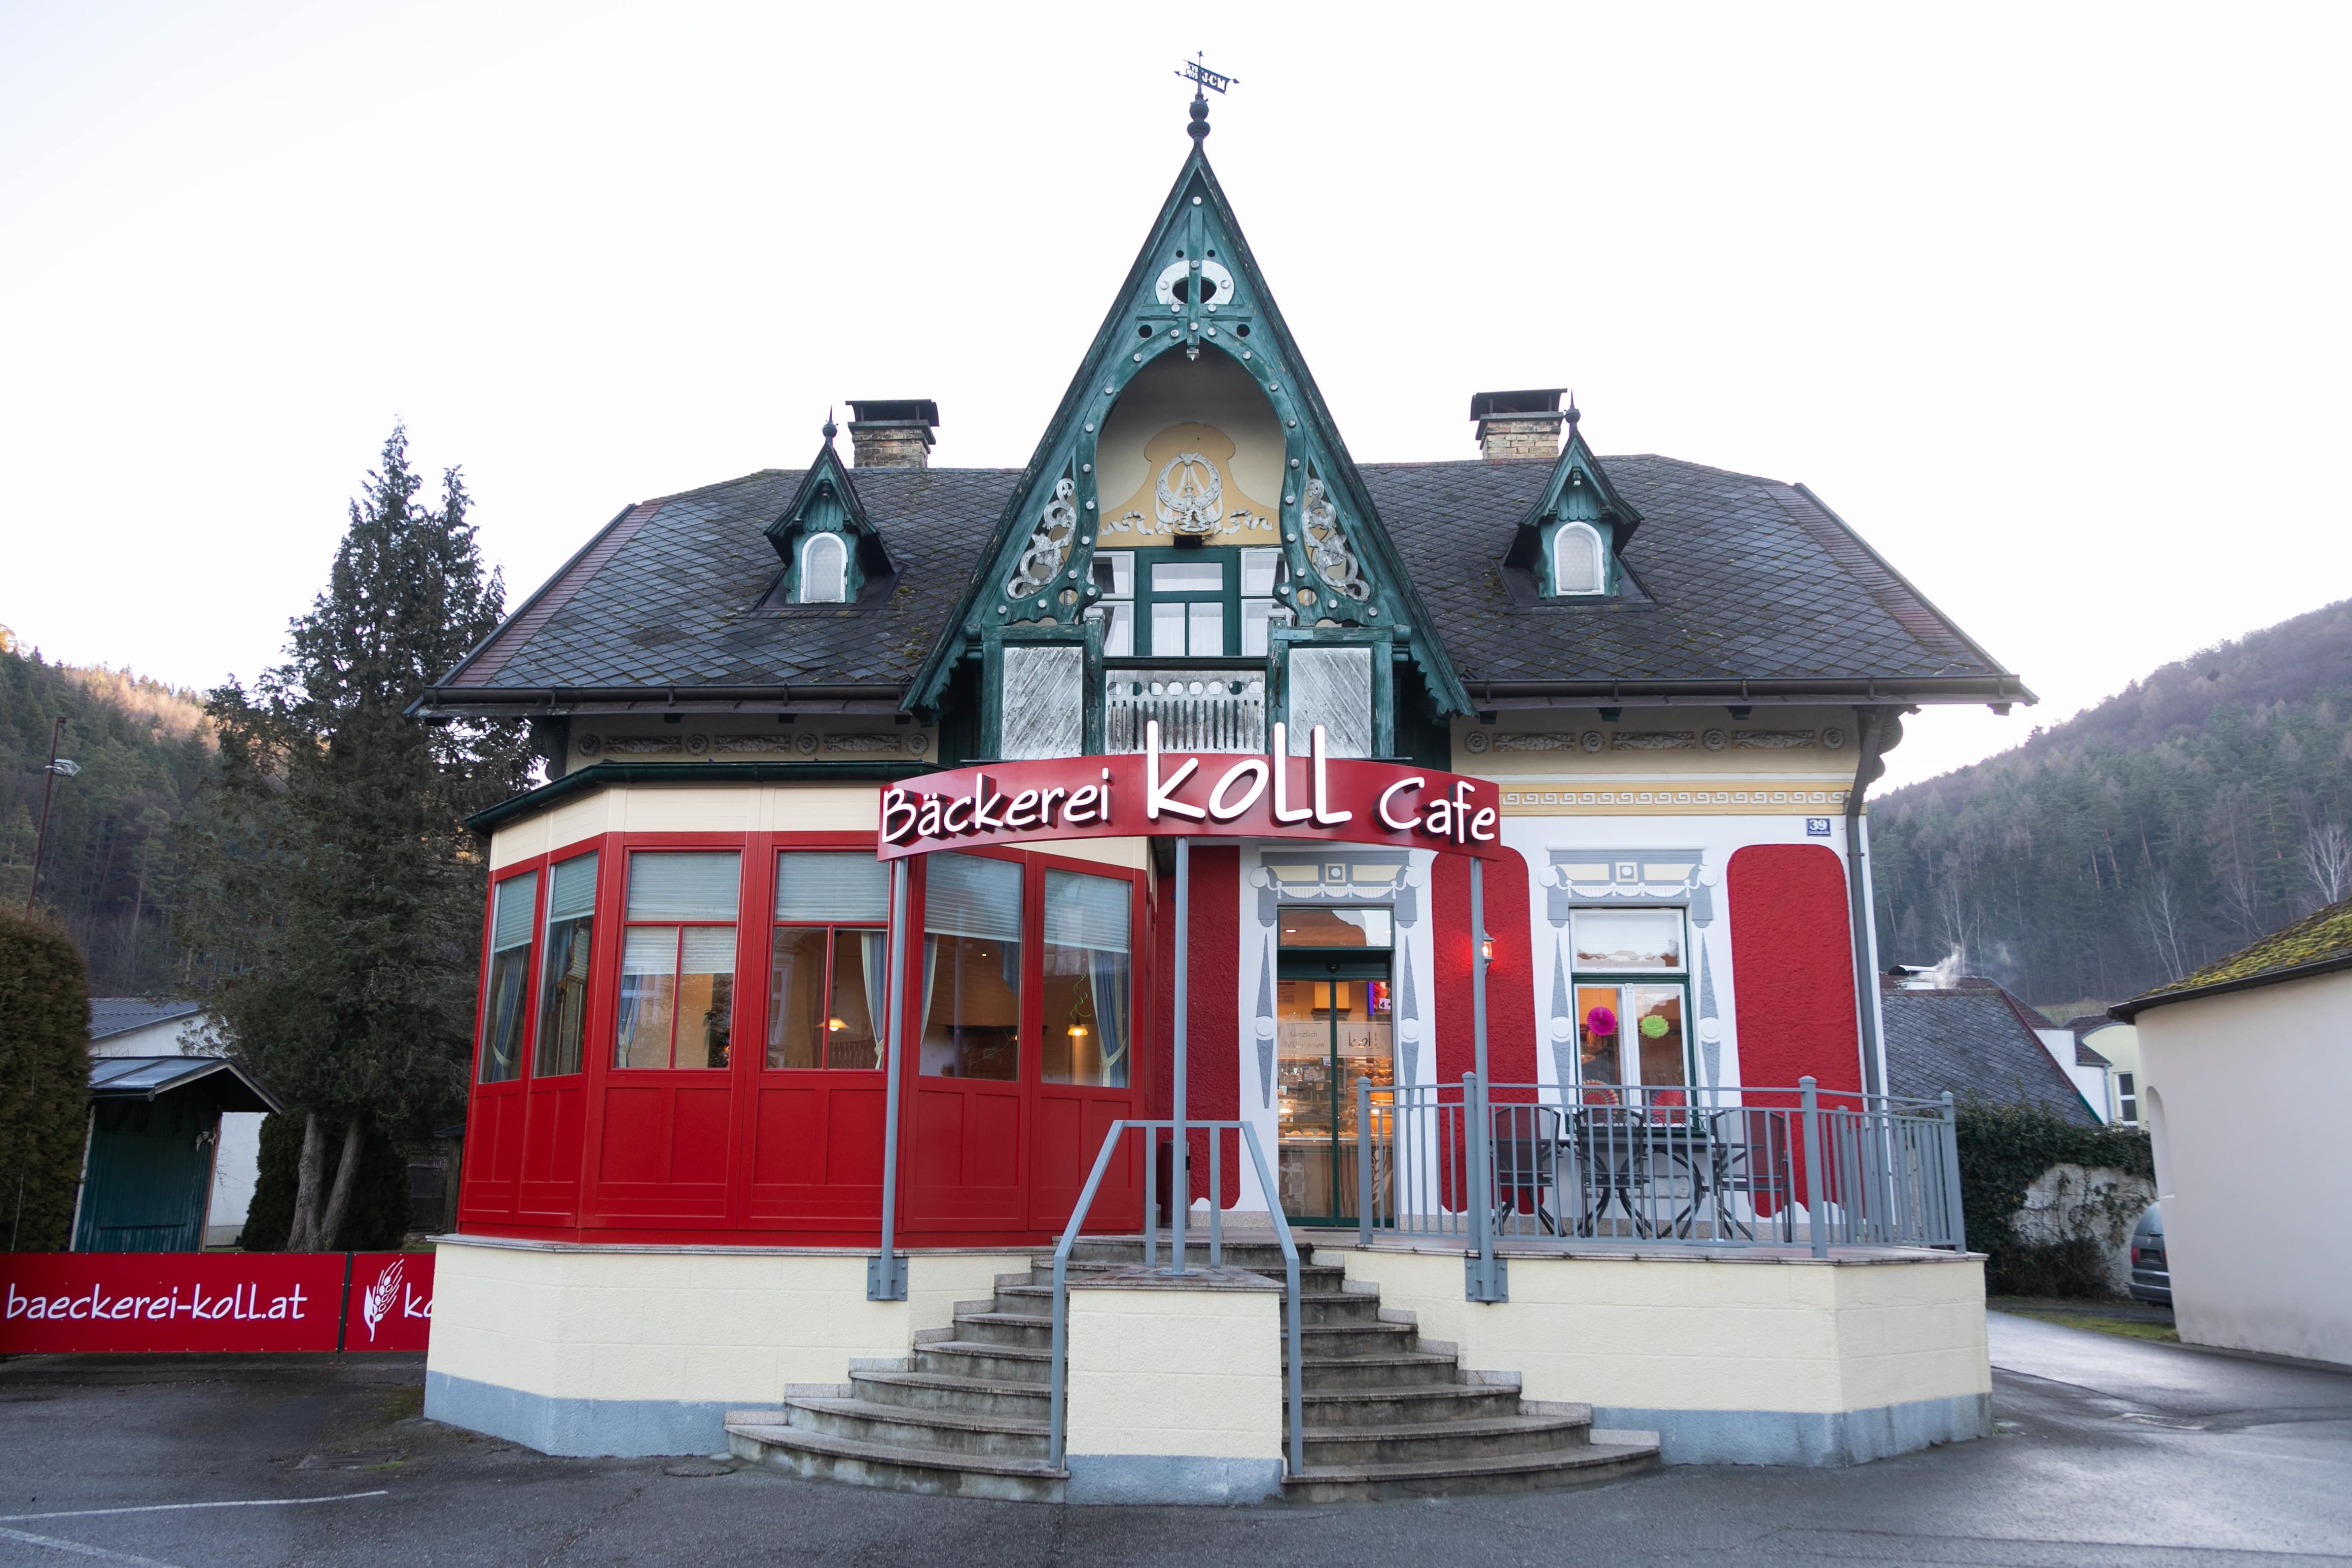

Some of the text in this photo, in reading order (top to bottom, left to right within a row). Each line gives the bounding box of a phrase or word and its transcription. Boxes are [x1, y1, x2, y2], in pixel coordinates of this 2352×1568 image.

[881, 767, 1110, 843] Bäckerei
[1379, 776, 1496, 844] Cafe
[1809, 819, 1827, 830] 39
